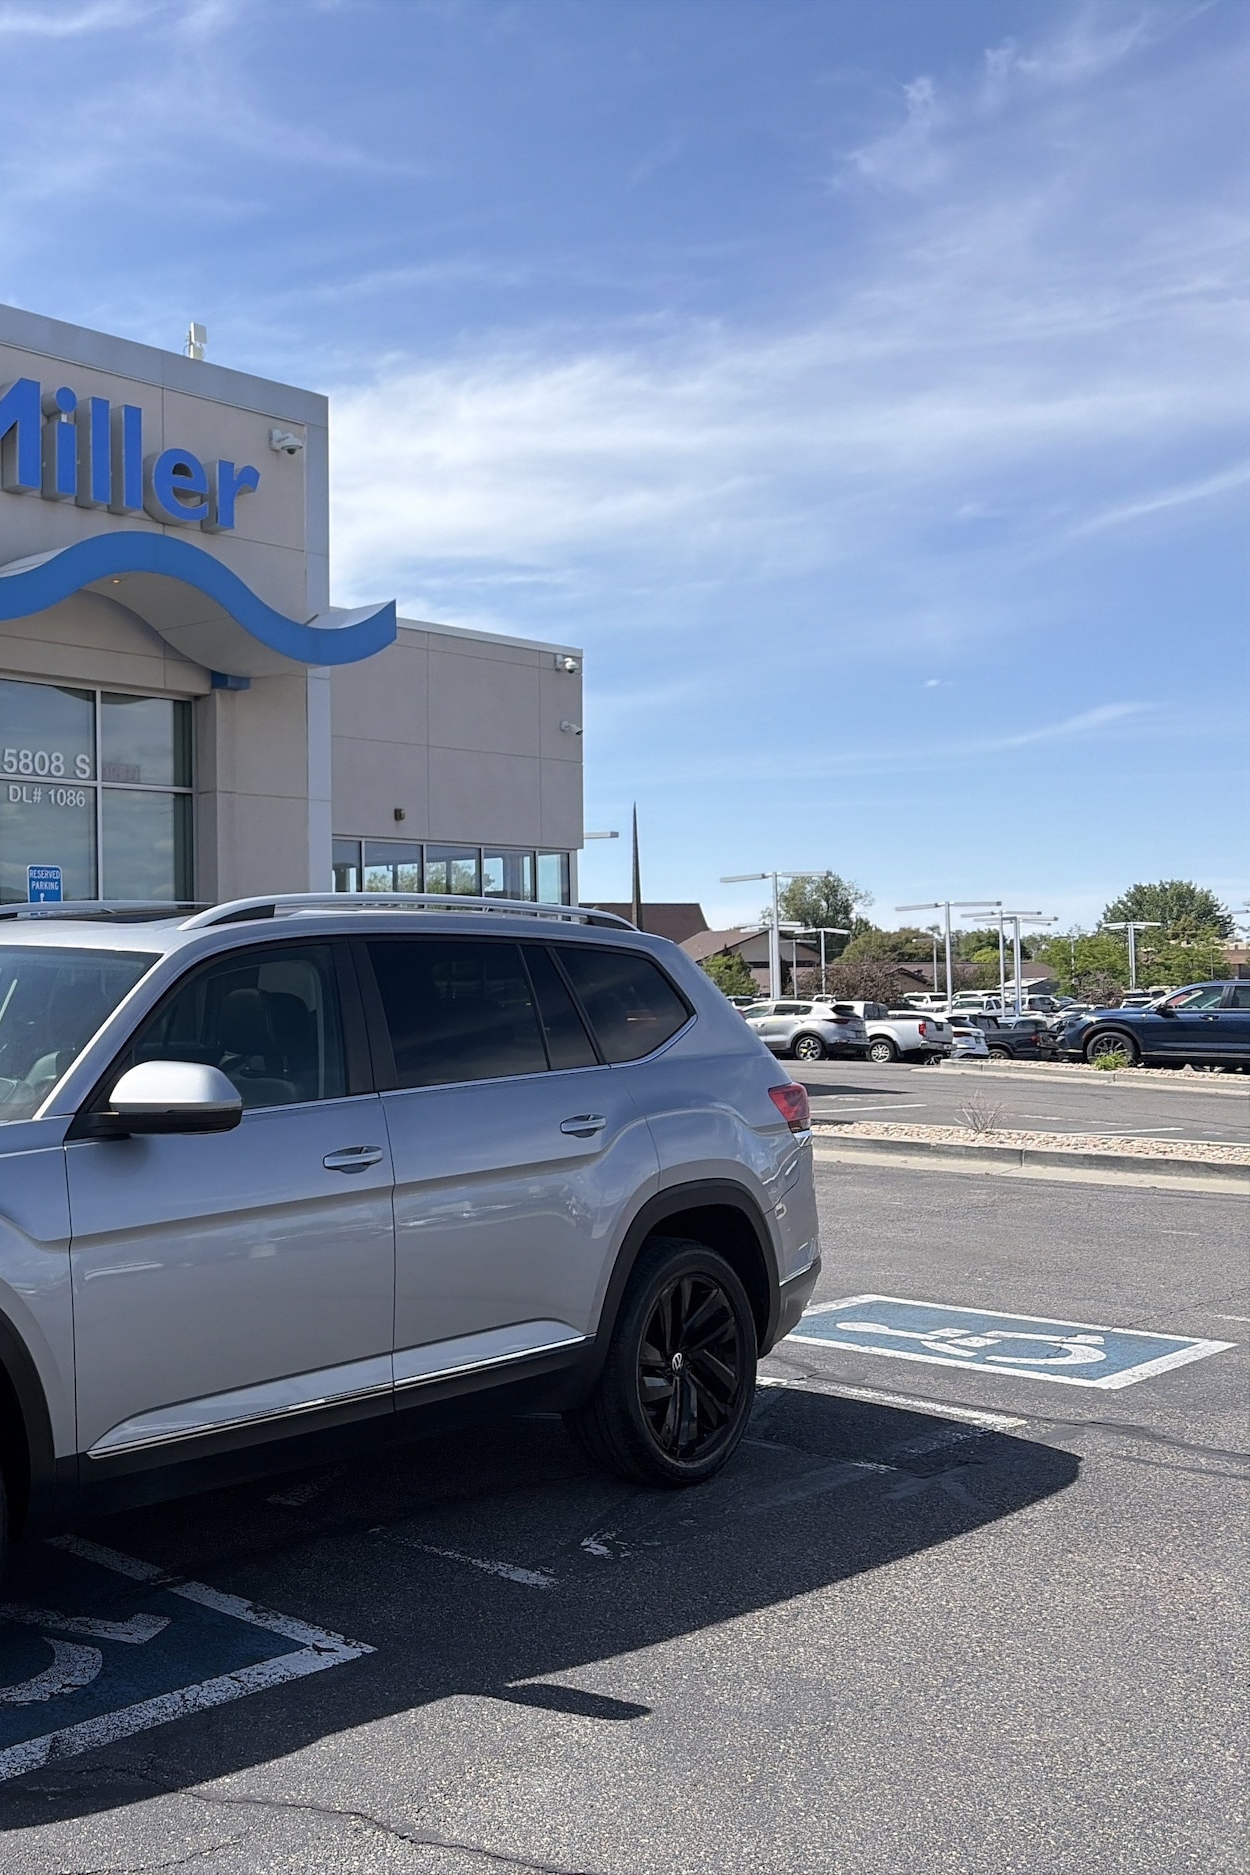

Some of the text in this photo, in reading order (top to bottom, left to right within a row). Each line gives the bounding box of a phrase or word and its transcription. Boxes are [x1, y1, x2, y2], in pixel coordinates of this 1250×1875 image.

[2, 747, 91, 779] 5808 S
[8, 784, 86, 807] DL# 1086
[29, 869, 61, 880] RESERVED
[31, 880, 60, 891] PARKING
